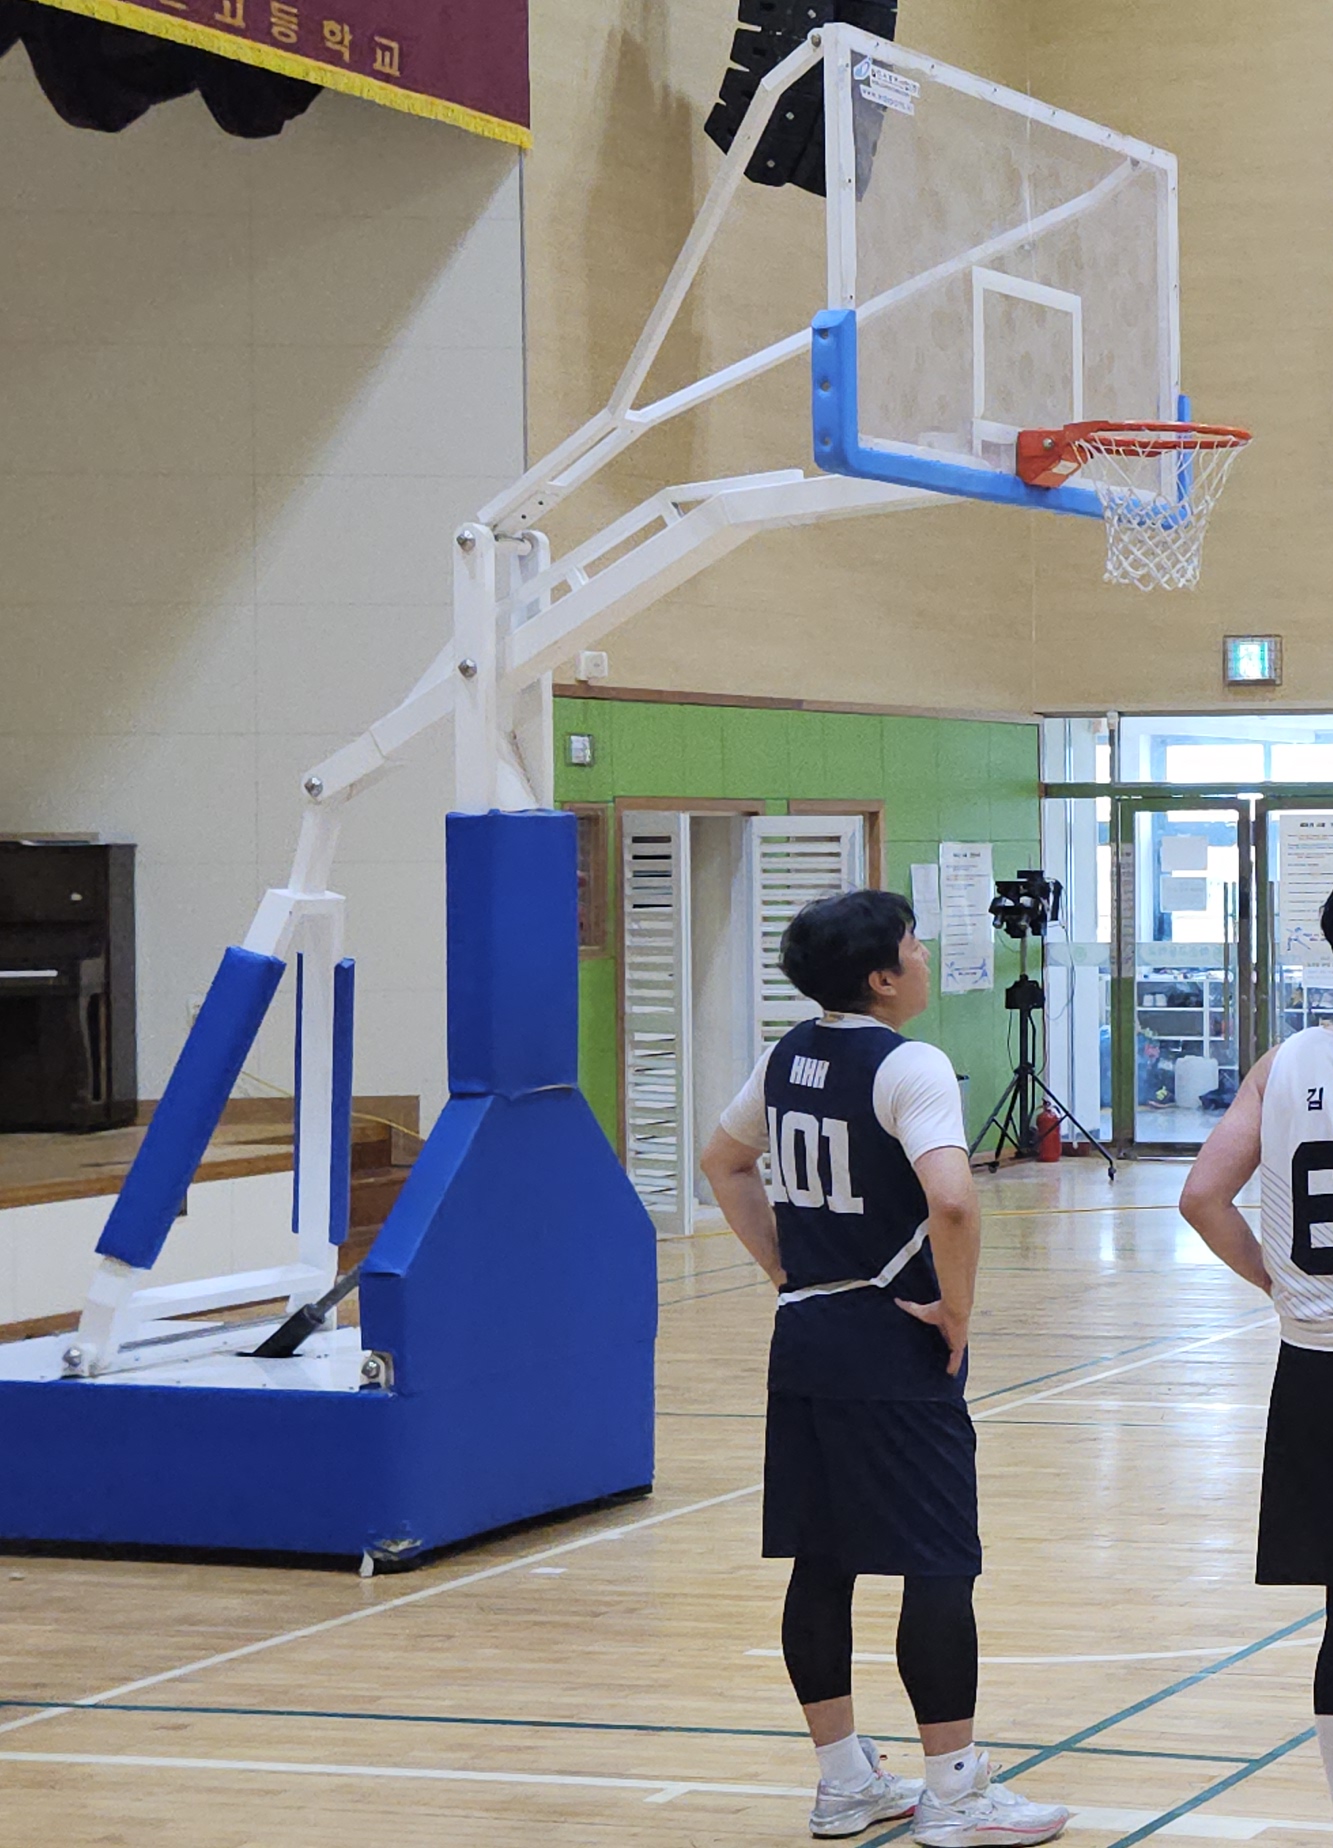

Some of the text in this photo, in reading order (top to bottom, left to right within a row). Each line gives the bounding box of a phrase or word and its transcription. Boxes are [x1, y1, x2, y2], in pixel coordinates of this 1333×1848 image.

[158, 0, 401, 77] 고등학교
[789, 1055, 830, 1089] HHH
[767, 1105, 865, 1215] 101
